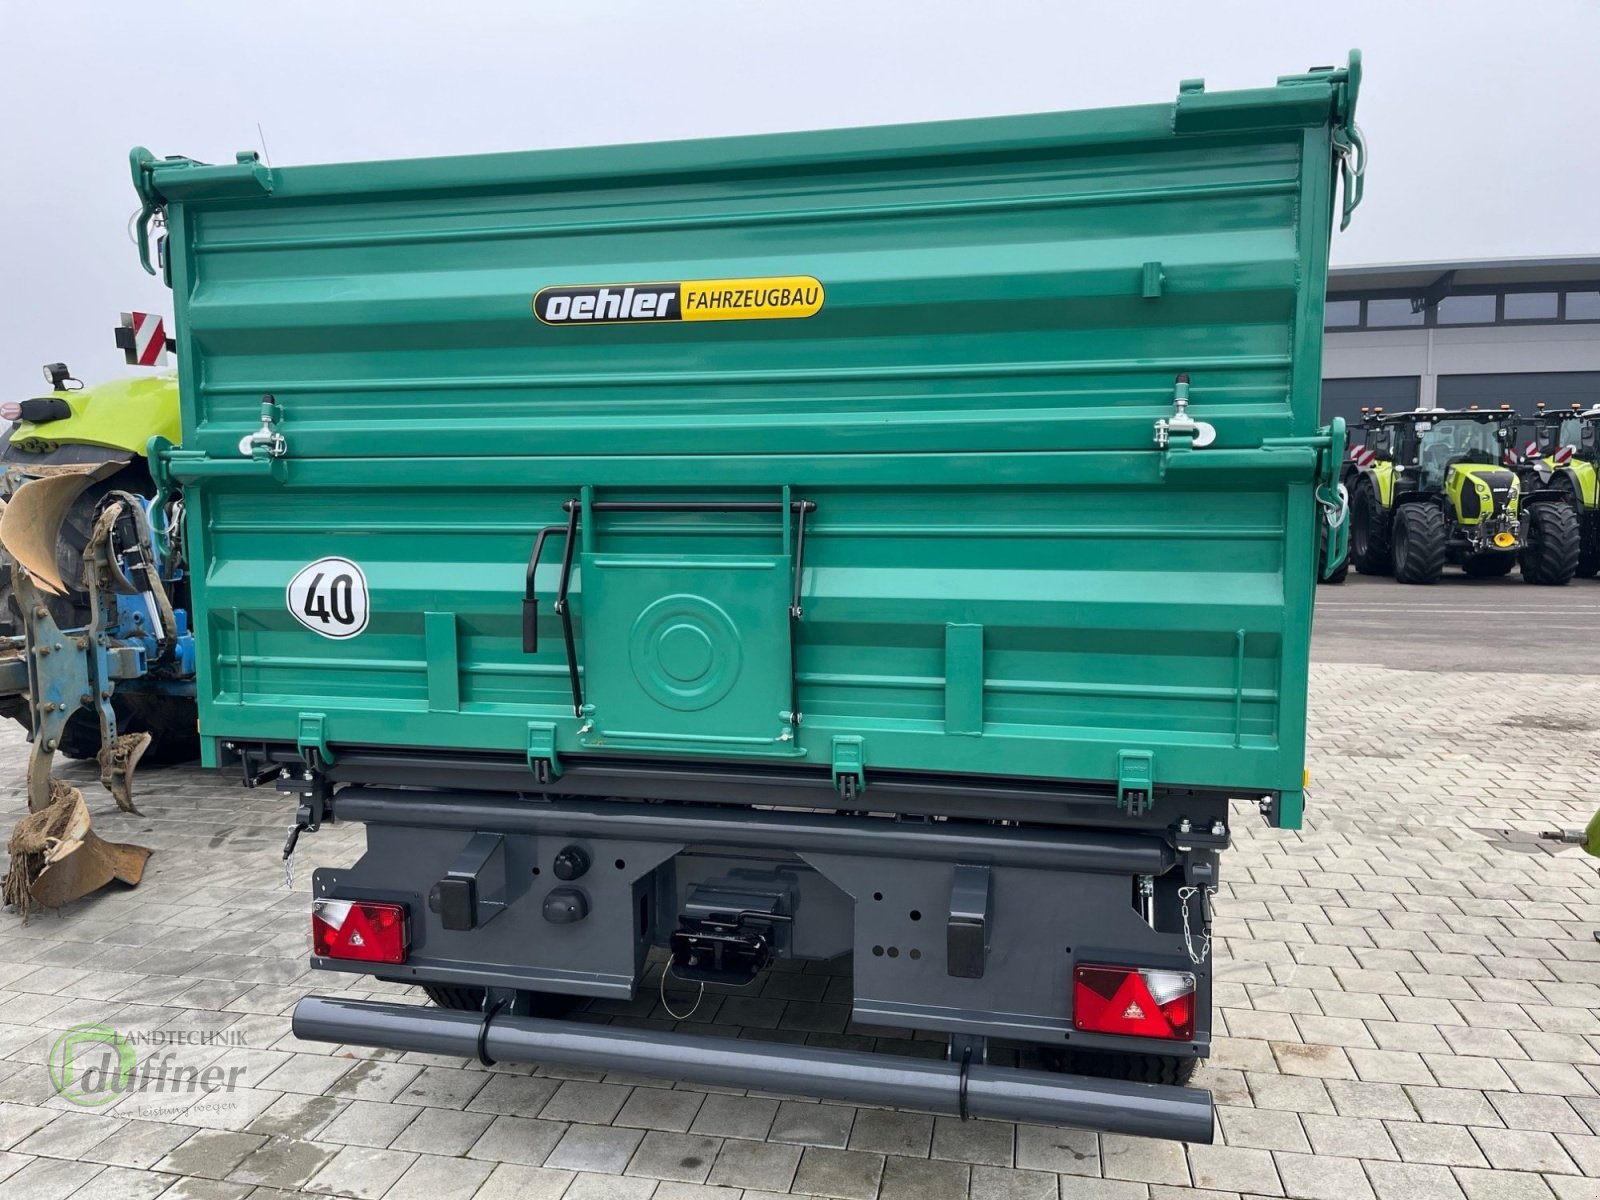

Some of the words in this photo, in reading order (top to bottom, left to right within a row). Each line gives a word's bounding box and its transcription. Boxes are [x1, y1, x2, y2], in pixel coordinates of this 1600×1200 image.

[545, 288, 676, 321] oehler
[686, 287, 819, 310] FAHRZEUGBAU
[304, 572, 355, 625] 40
